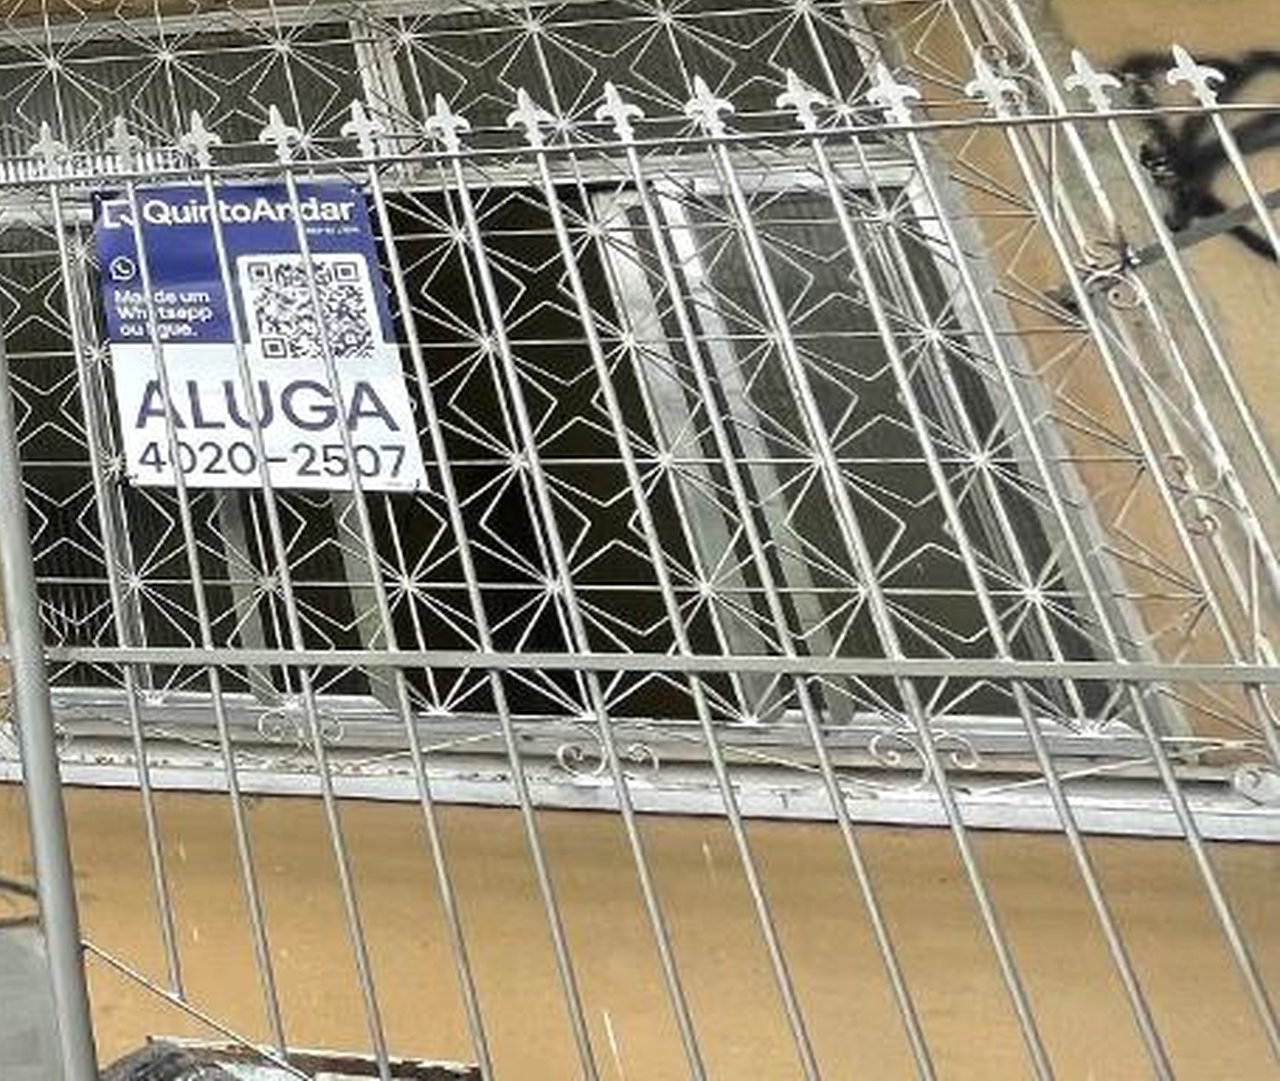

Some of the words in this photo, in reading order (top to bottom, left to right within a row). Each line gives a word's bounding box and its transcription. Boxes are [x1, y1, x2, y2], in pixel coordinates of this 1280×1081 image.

[142, 196, 356, 226] QuintoAndar
[114, 290, 177, 304] Made
[179, 292, 210, 303] um
[120, 324, 144, 336] ou
[135, 379, 400, 432] ALUGA
[139, 441, 406, 478] 4020-2507
